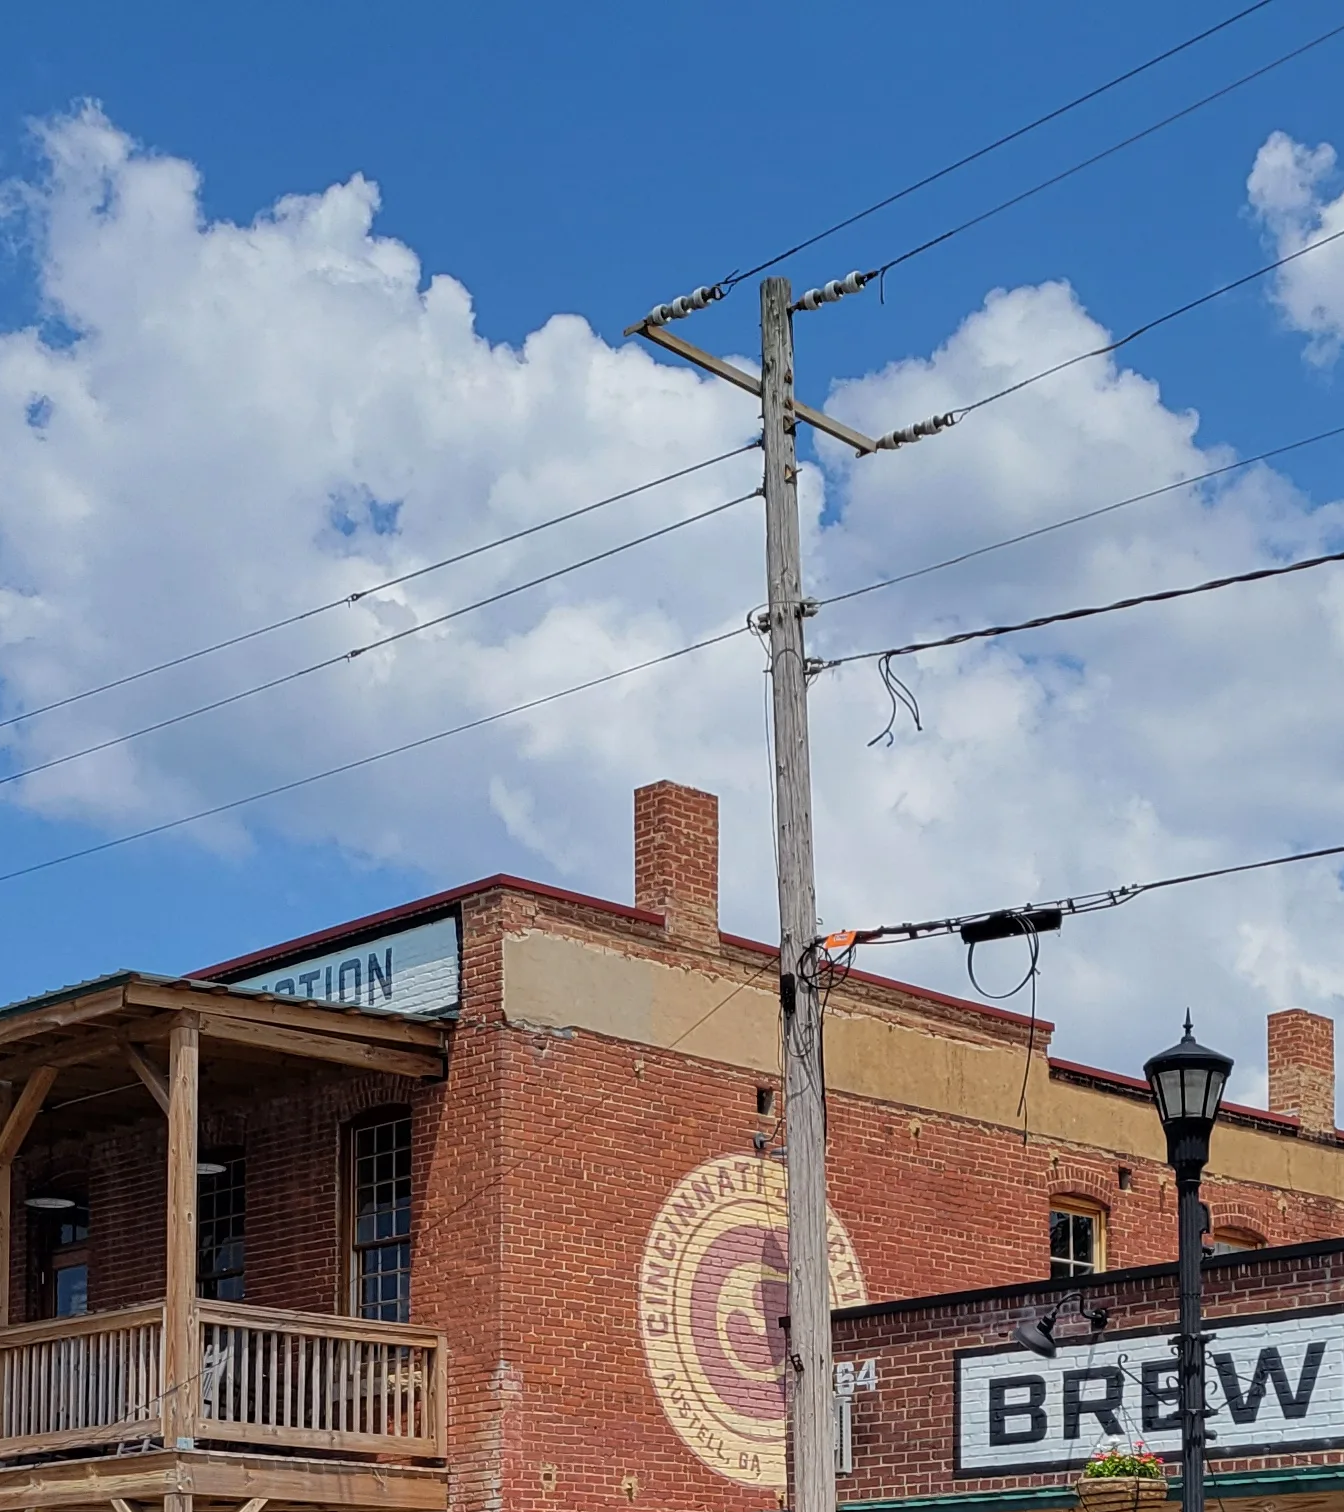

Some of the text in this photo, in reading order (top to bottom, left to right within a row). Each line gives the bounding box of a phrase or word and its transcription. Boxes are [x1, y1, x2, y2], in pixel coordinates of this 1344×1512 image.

[261, 947, 393, 1006] TION
[646, 1161, 764, 1338] CINCINNATI
[832, 1359, 878, 1395] 64
[662, 1372, 761, 1473] AUSTELL, GA
